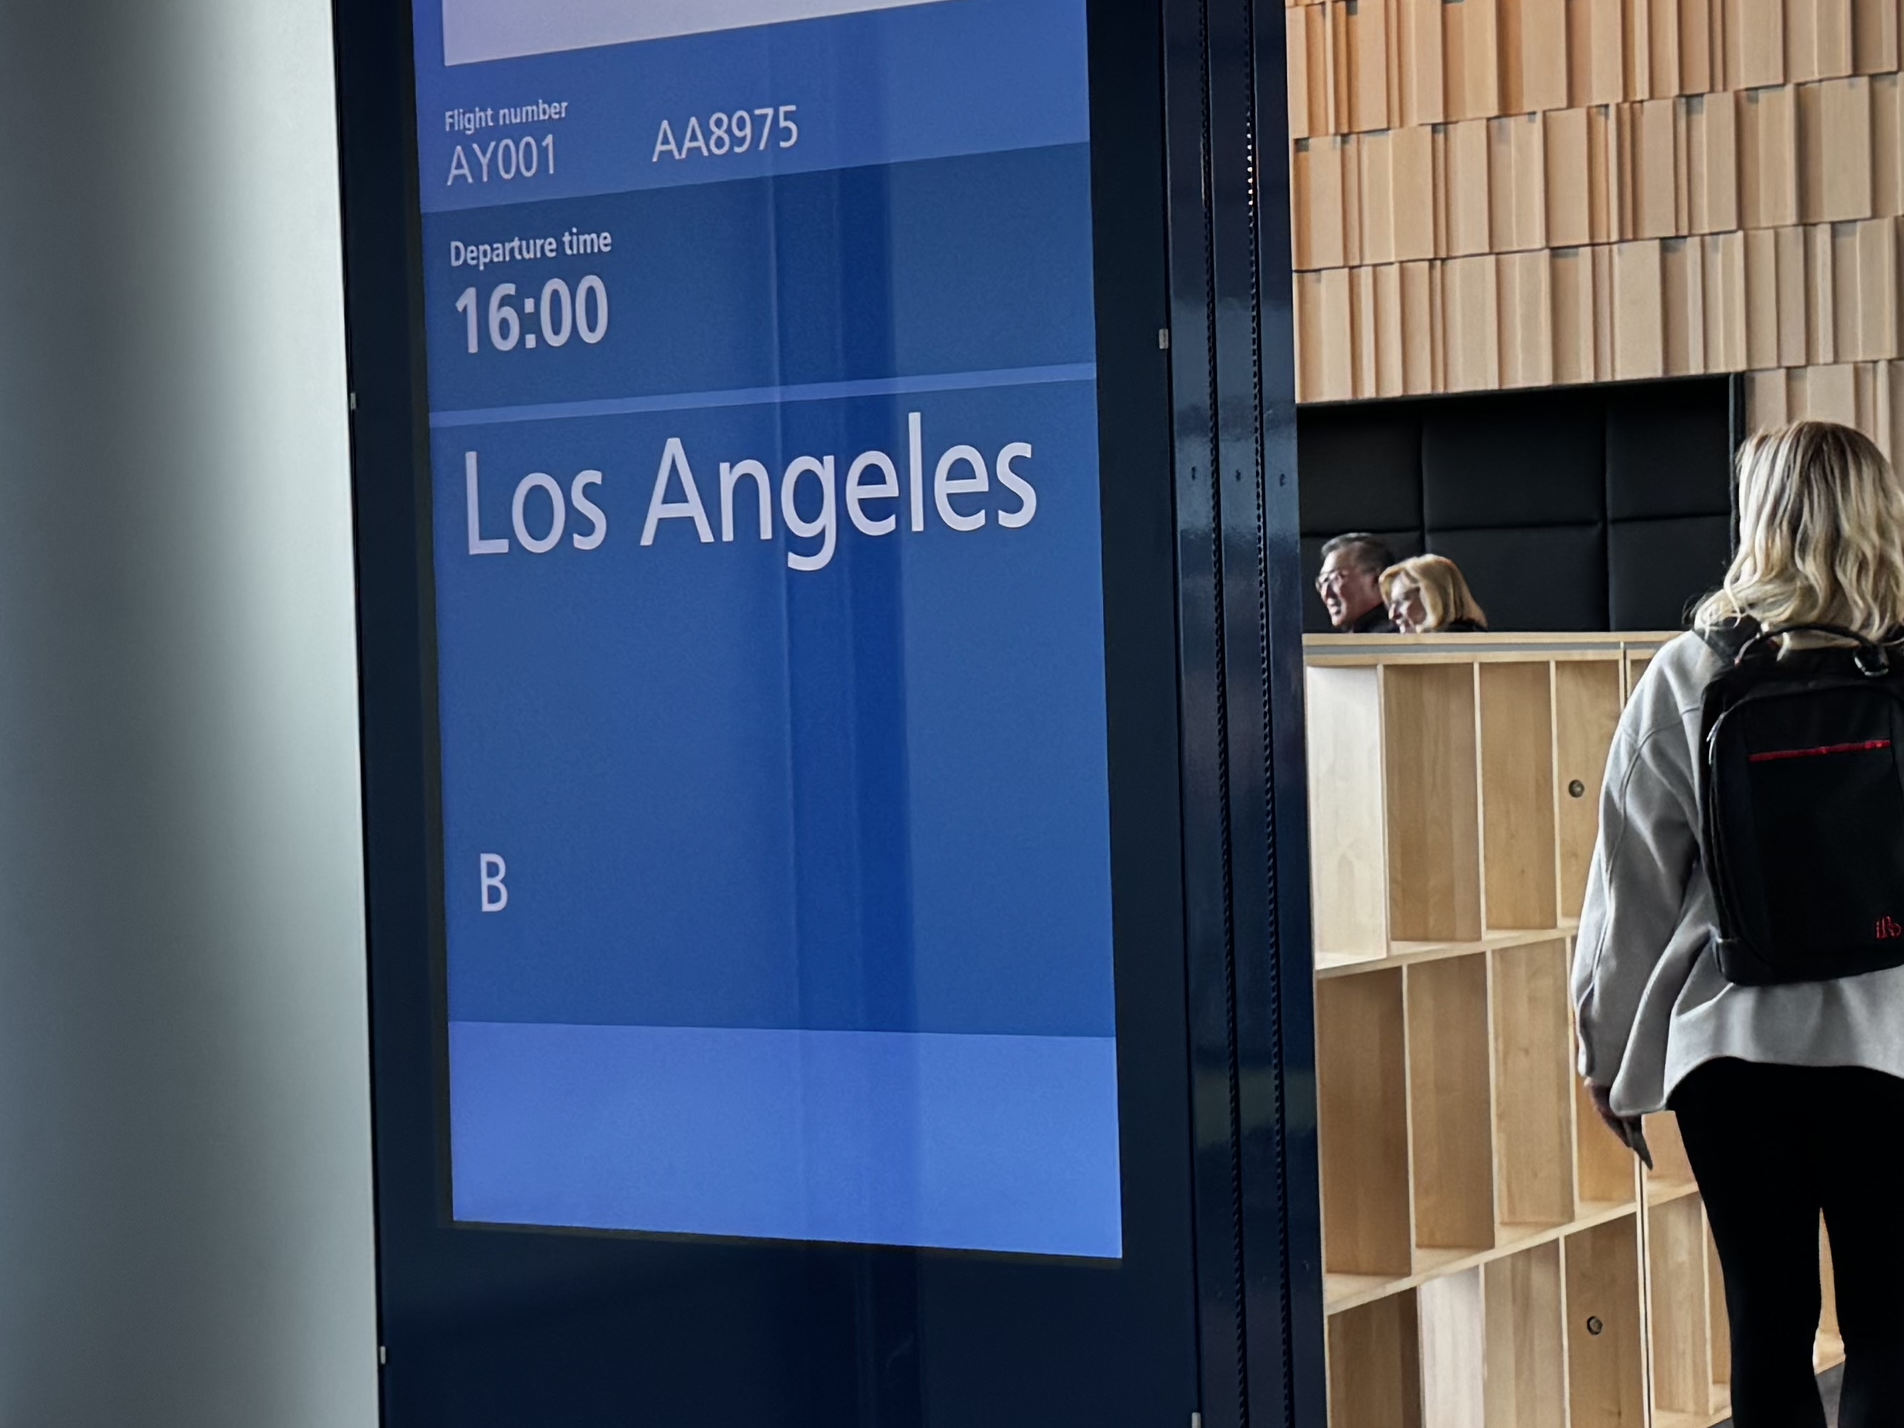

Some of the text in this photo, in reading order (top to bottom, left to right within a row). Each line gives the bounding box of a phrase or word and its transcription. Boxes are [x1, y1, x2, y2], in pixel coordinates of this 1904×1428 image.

[445, 99, 568, 135] Flight number
[446, 104, 799, 186] AY001 AA8975
[450, 227, 612, 271] Departure time
[455, 274, 609, 354] 16:00
[464, 411, 1038, 572] Los Angeles
[479, 852, 509, 913] B
